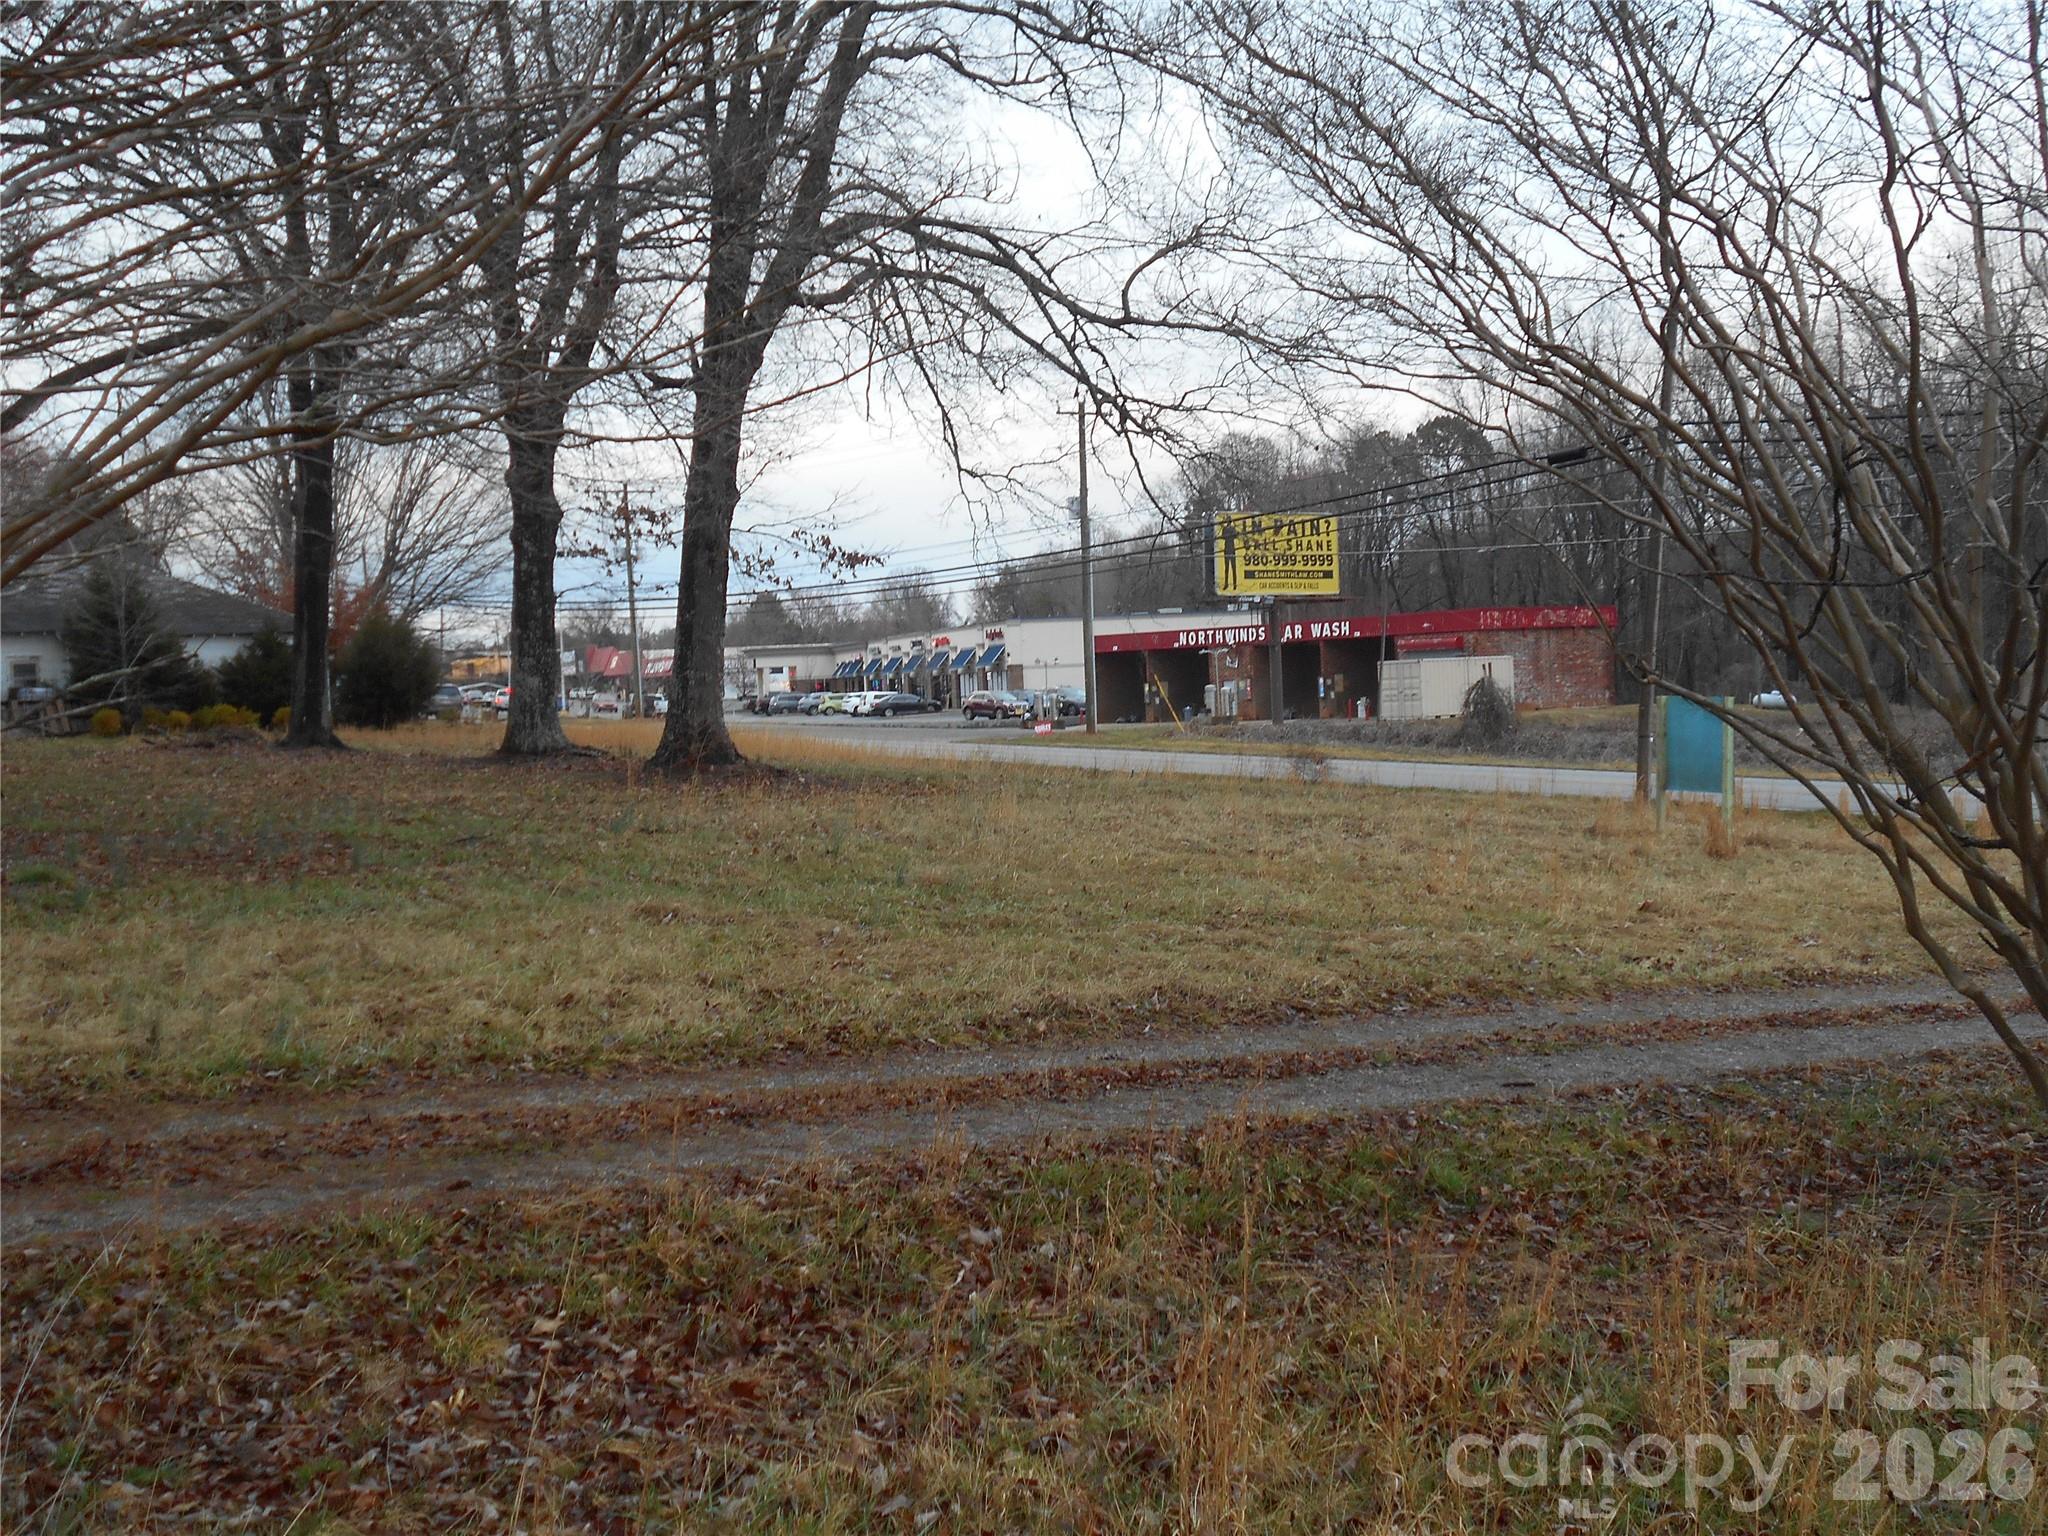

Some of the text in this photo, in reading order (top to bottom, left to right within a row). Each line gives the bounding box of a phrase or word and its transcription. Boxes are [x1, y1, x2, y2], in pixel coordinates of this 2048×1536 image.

[1242, 518, 1331, 537] IN PAIN?
[1286, 540, 1332, 551] SHANE
[1179, 621, 1350, 646] NORTHWINDS AR WASH
